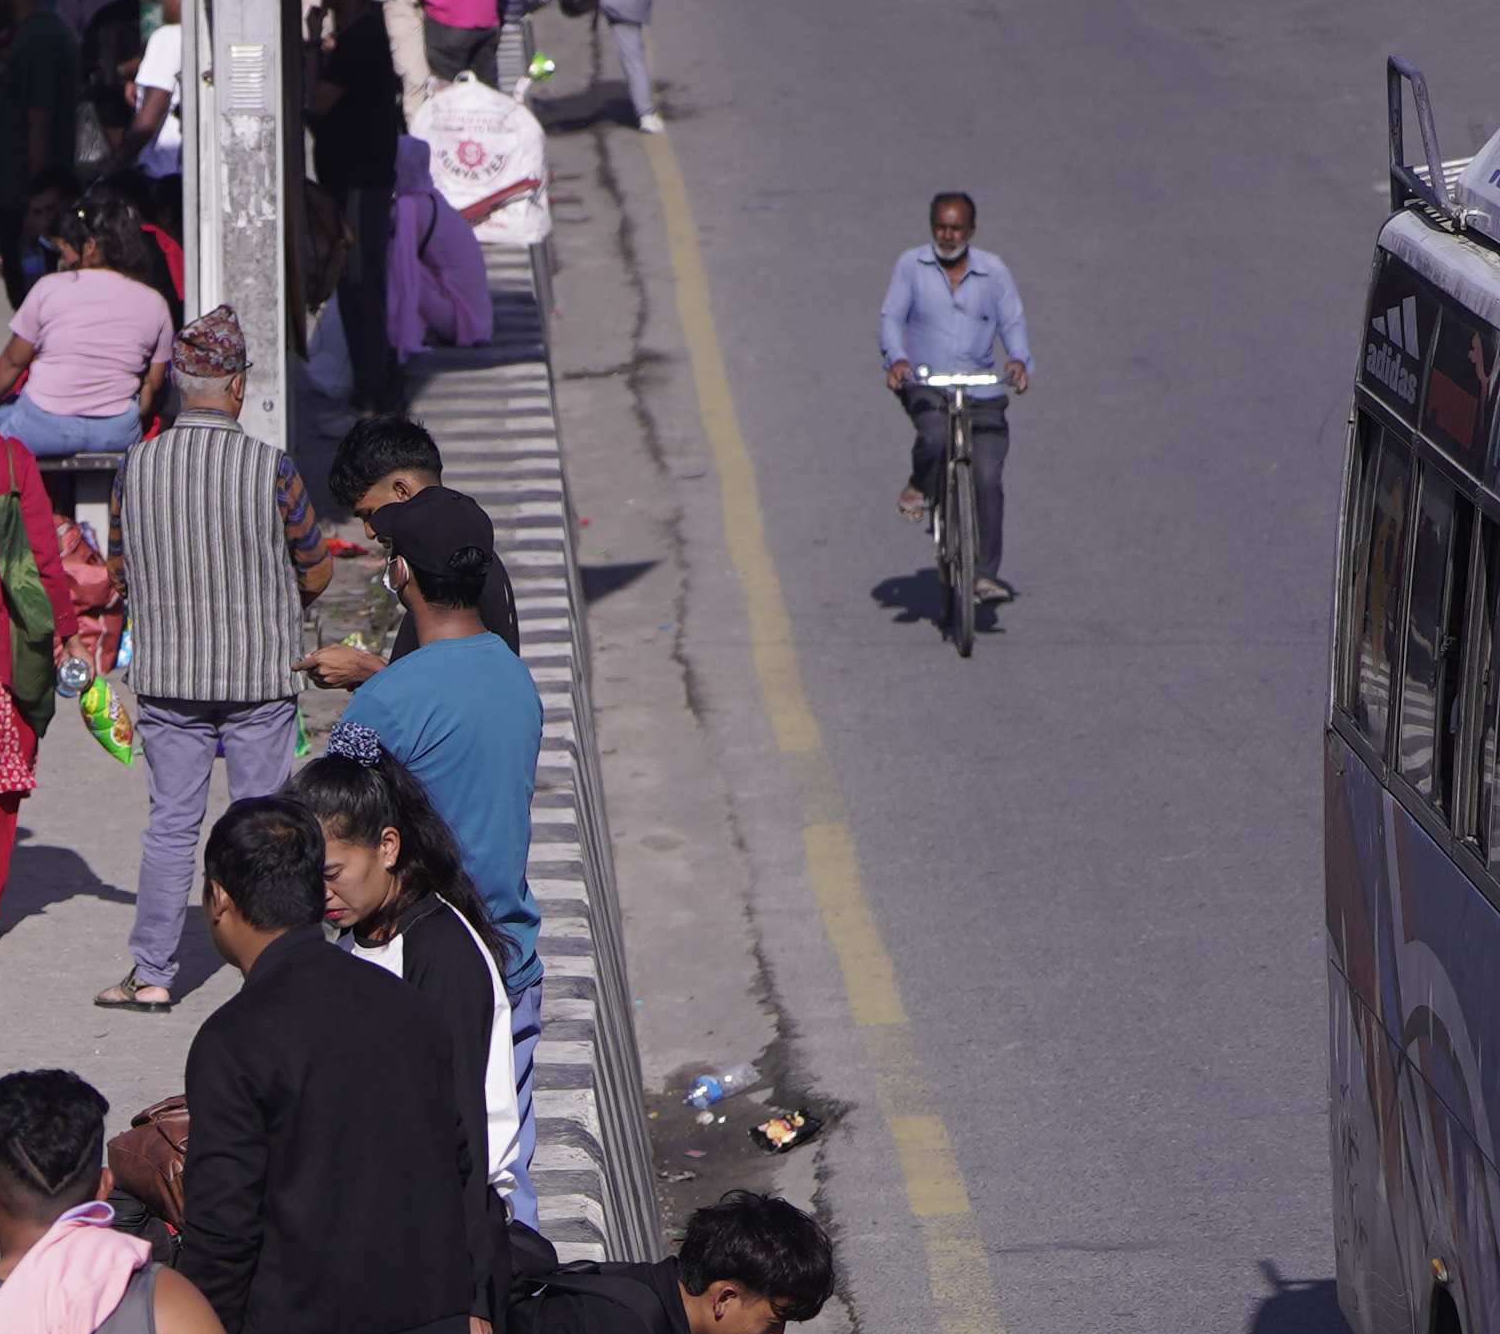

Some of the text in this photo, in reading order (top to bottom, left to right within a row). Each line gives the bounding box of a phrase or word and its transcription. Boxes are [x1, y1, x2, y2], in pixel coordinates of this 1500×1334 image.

[437, 149, 506, 182] SURYA TEA
[1365, 341, 1418, 406] adidas
